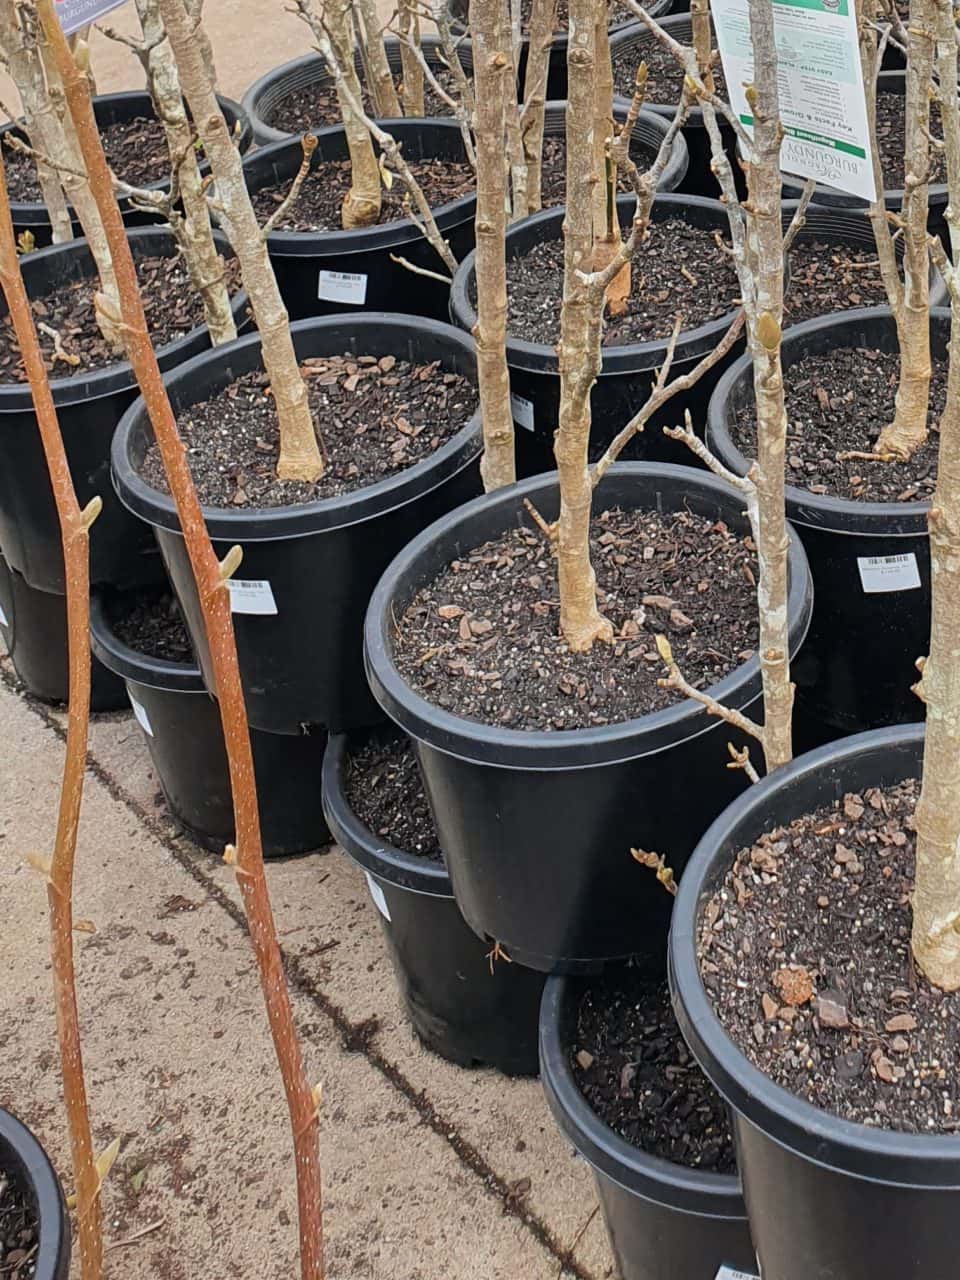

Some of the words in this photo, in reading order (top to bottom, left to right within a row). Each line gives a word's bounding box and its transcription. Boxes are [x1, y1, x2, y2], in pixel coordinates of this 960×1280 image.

[815, 115, 837, 127] Facts
[839, 122, 852, 131] Key
[786, 143, 857, 174] BURGUNDY
